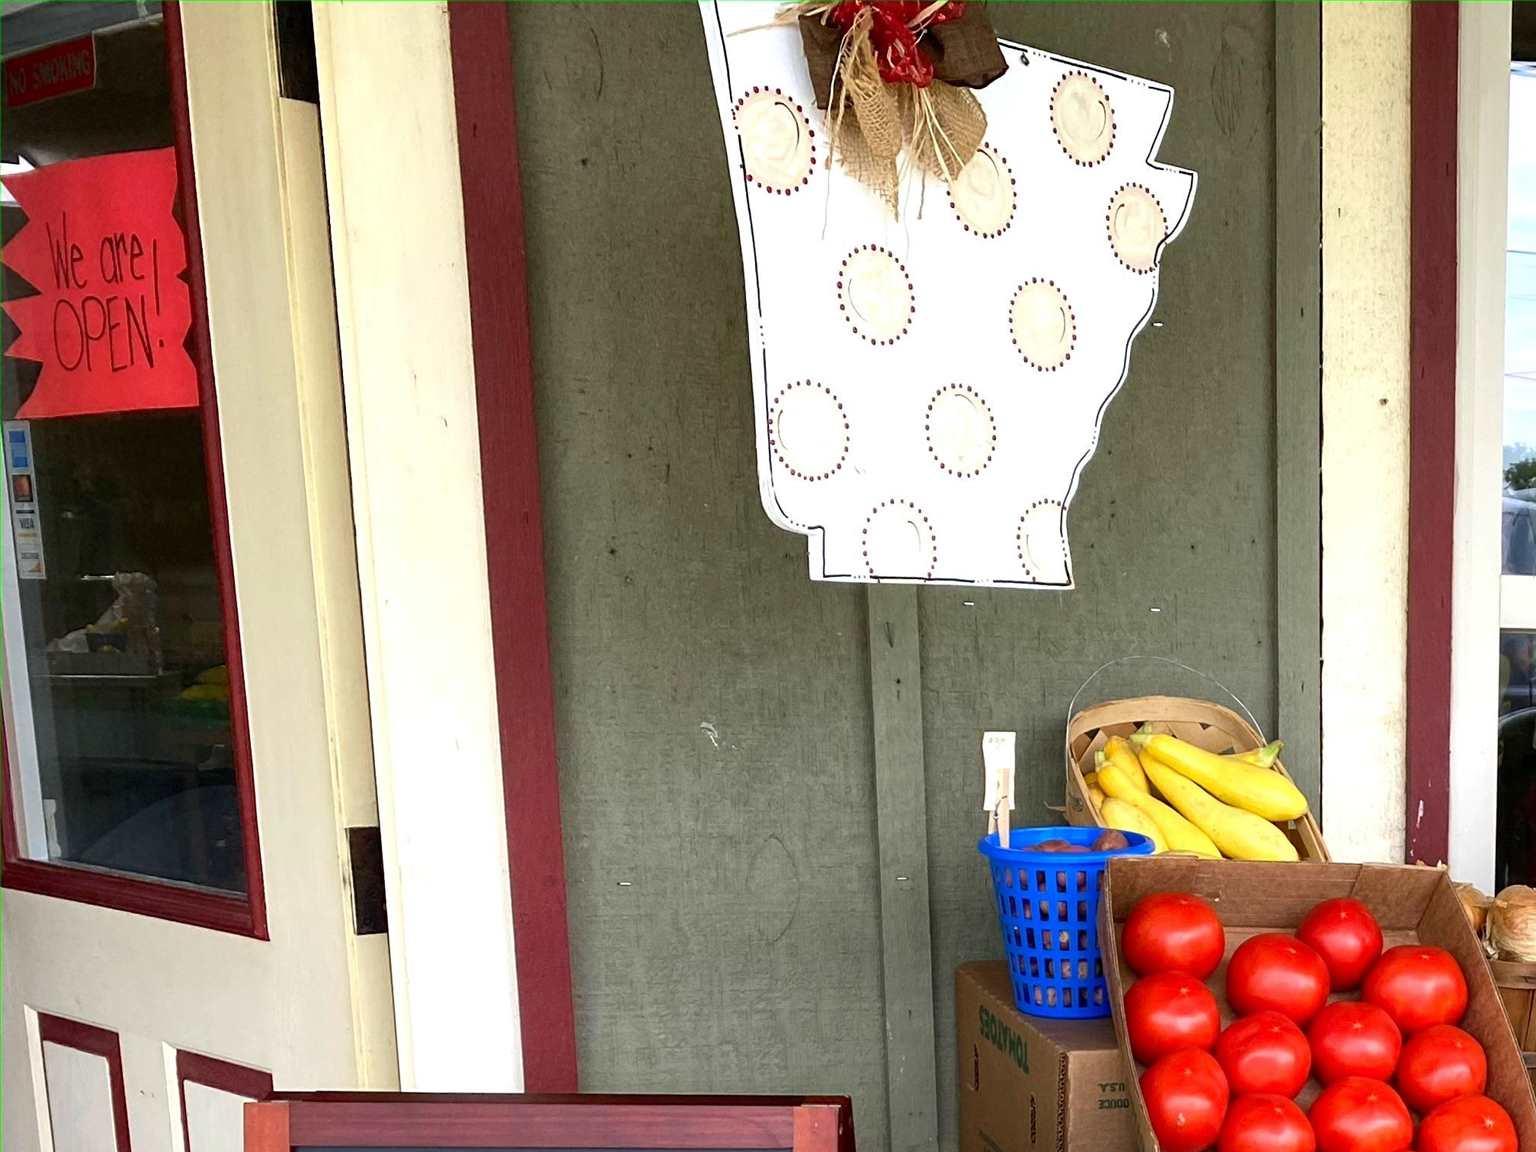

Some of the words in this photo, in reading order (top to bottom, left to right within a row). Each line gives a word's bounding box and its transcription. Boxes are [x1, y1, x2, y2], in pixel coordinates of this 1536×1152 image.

[8, 67, 26, 97] NO
[32, 49, 90, 89] SMOKING
[46, 210, 87, 289] We
[100, 232, 145, 285] are
[53, 239, 164, 373] OPEN!
[979, 1004, 1030, 1075] TOMATOES
[1098, 1098, 1130, 1110] ODUCE
